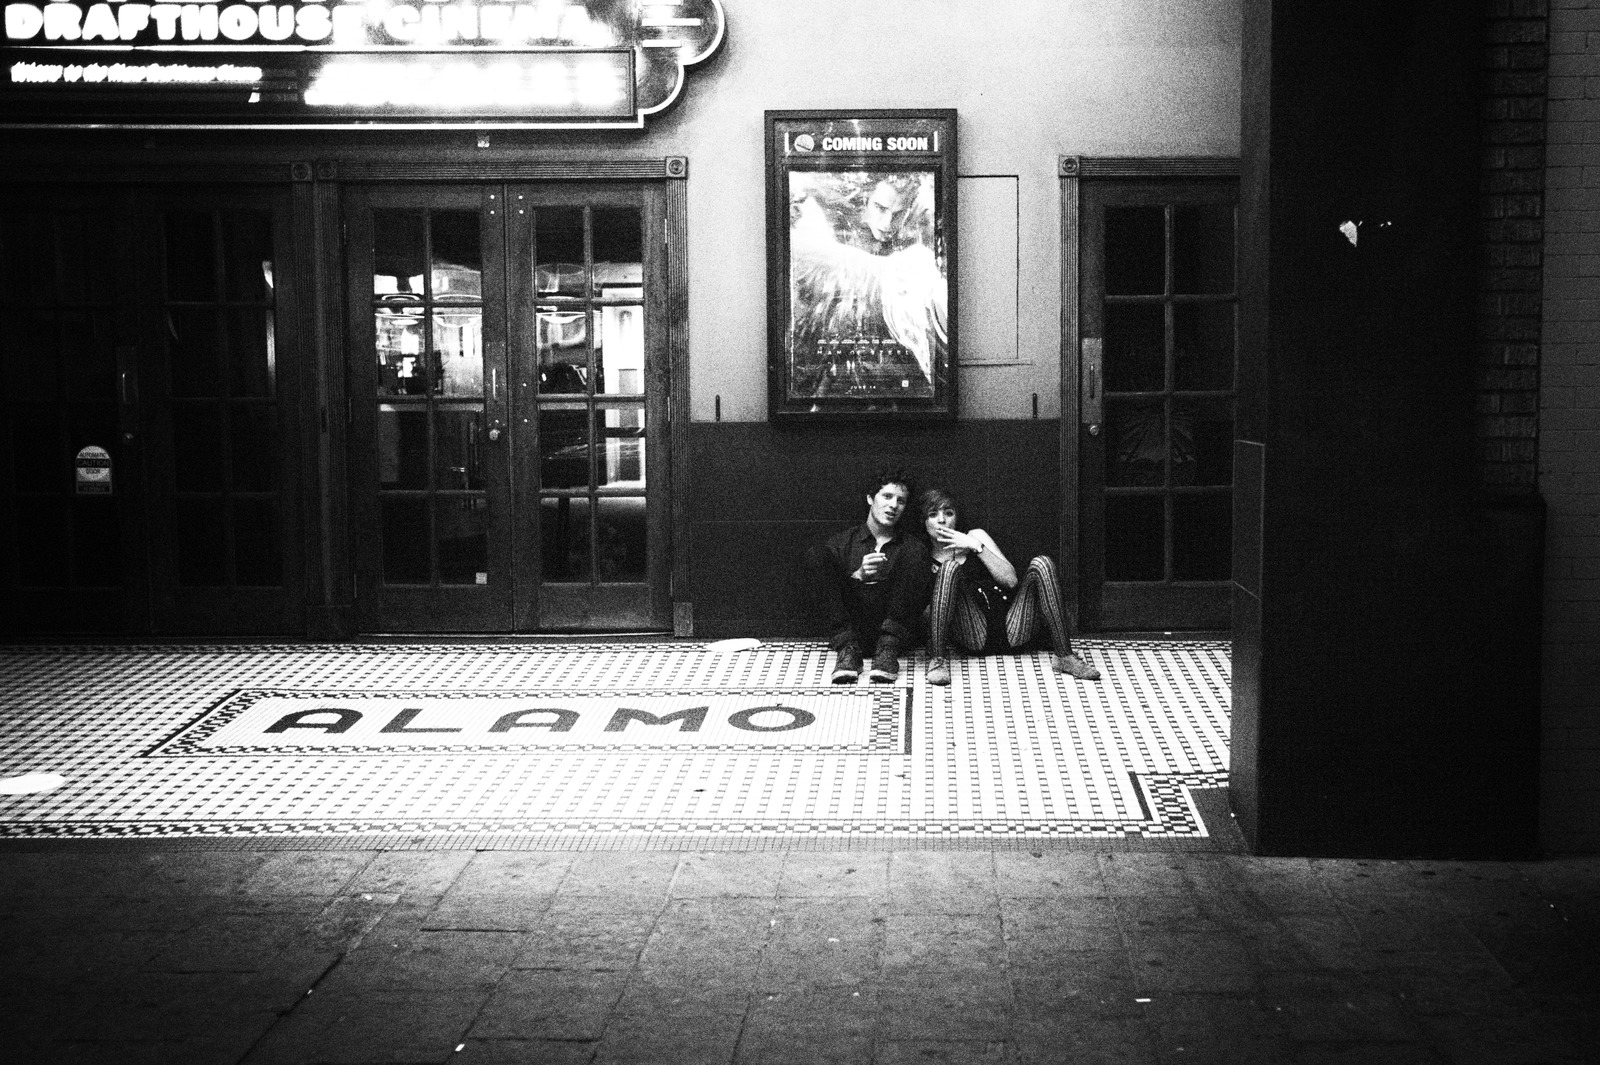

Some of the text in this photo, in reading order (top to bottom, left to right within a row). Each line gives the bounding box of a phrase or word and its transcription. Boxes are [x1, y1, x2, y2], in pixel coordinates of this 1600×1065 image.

[5, 3, 598, 41] DRAFTHOUSE CINEMA
[822, 137, 928, 151] COMING SOON
[263, 705, 817, 734] ALAMO
